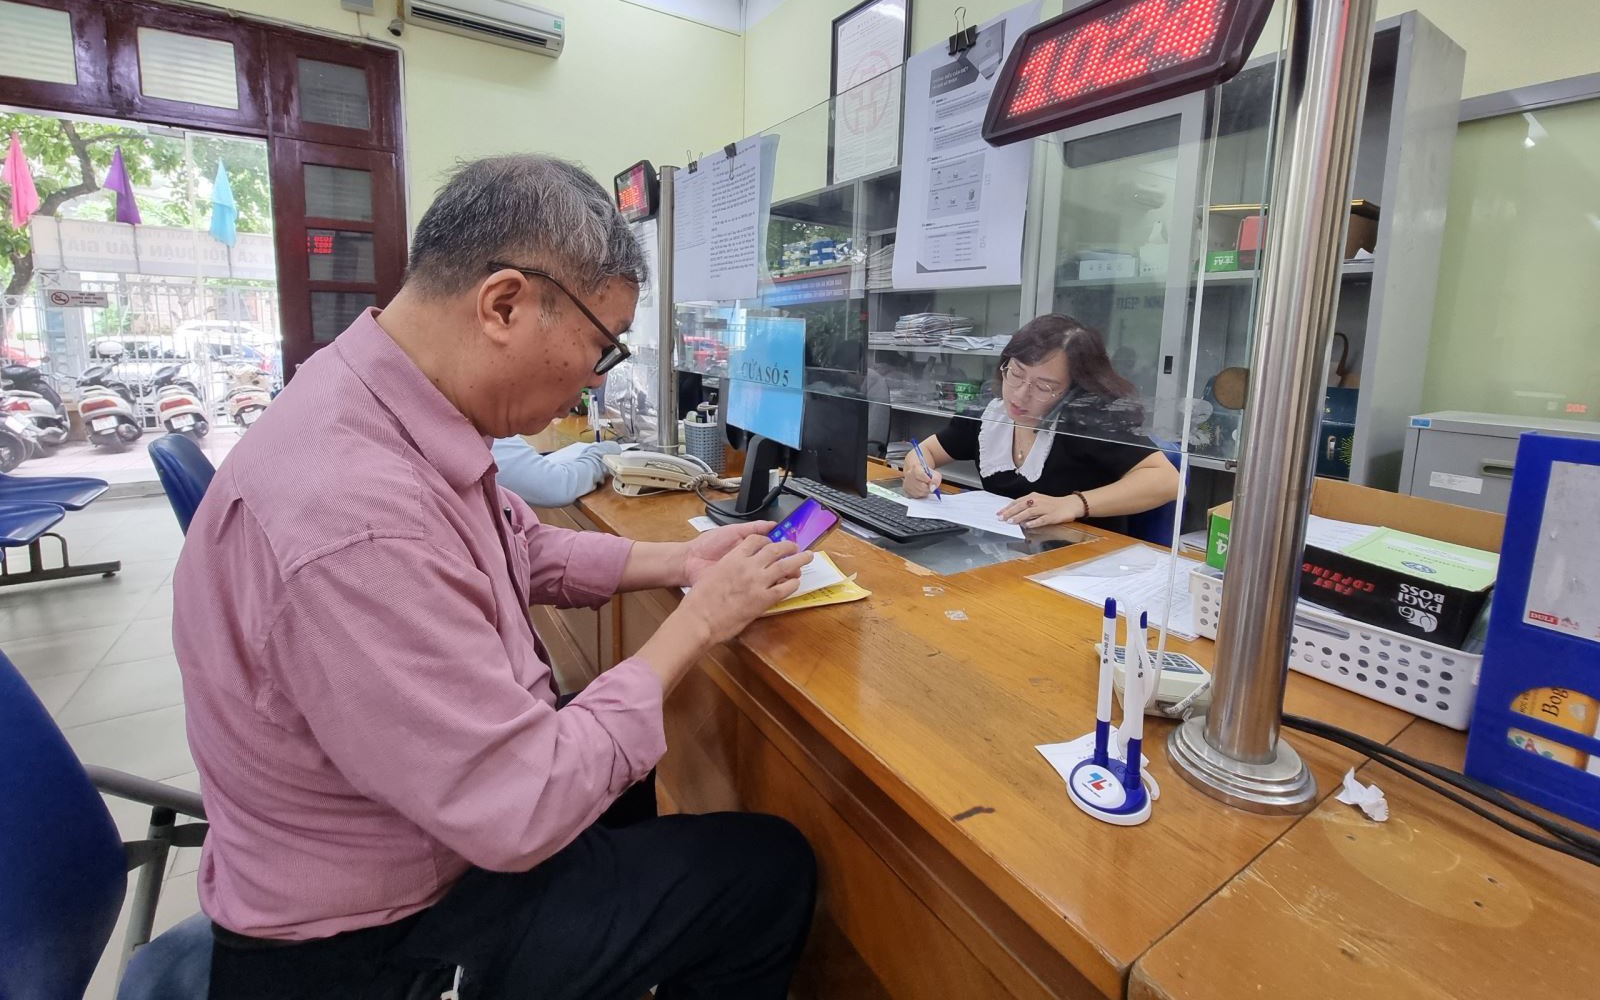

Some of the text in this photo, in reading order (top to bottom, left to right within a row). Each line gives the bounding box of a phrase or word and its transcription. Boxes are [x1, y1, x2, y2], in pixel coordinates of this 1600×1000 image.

[782, 369, 790, 387] 5
[1302, 562, 1376, 593] COPYING
[1313, 577, 1355, 595] FAST
[1397, 592, 1442, 614] PAGI
[1398, 583, 1445, 604] BOSS
